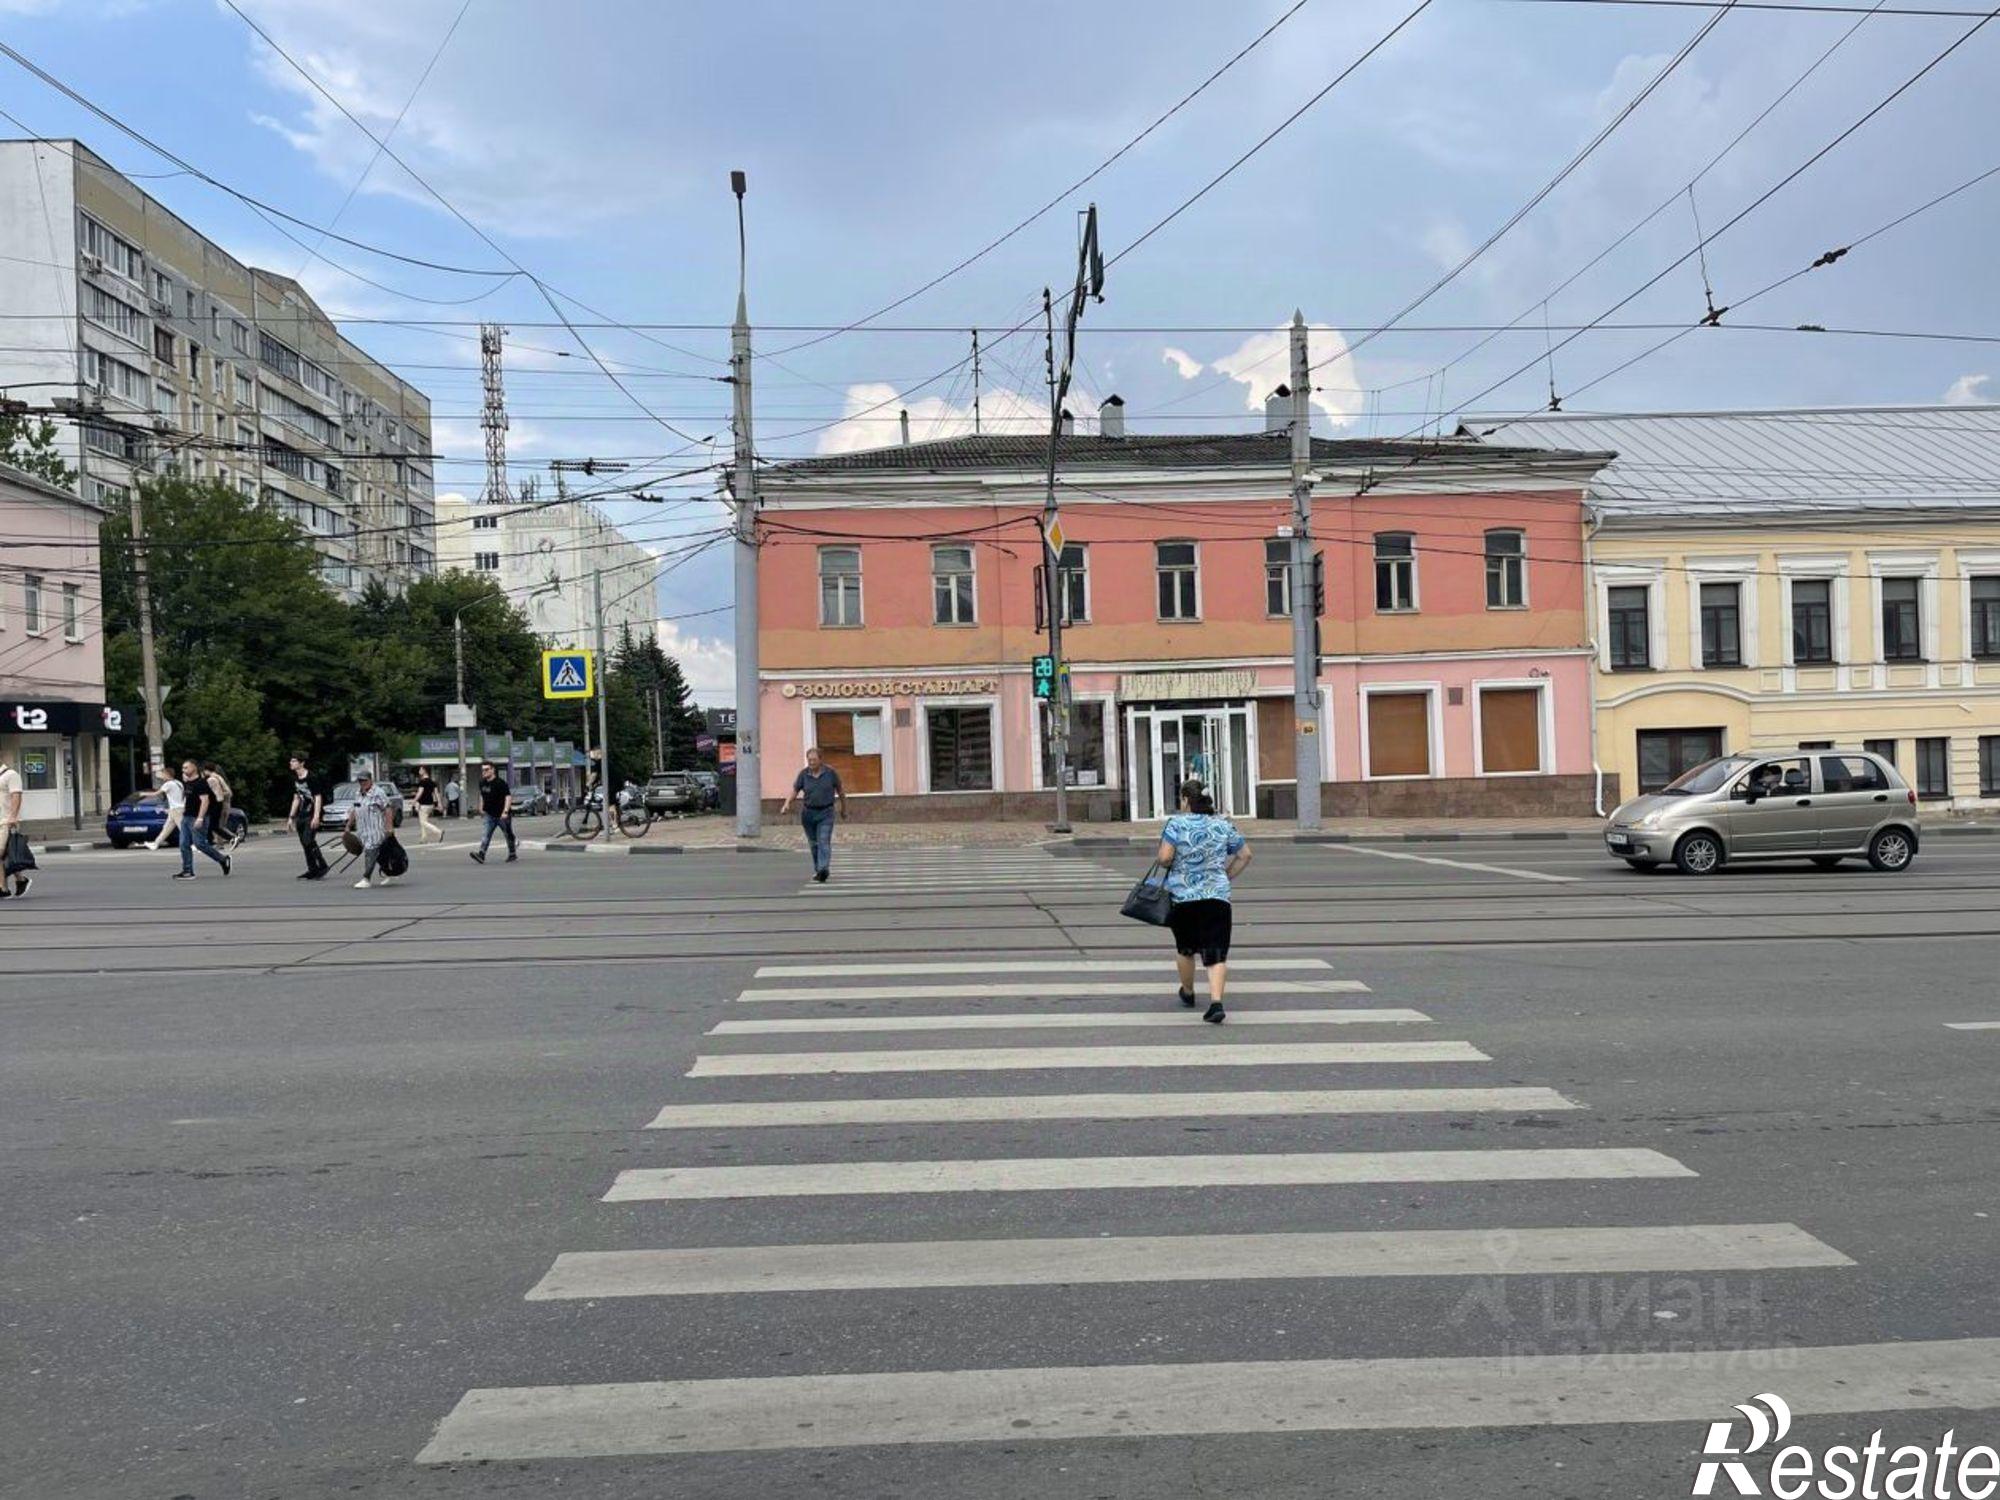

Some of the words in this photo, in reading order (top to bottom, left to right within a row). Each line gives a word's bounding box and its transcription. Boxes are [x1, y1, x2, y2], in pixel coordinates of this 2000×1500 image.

[1035, 658, 1052, 676] 28
[802, 679, 894, 697] ЗОЛОТОЙ
[899, 678, 998, 696] СТАНДАРТ
[17, 705, 48, 730] t2
[104, 707, 121, 730] t2
